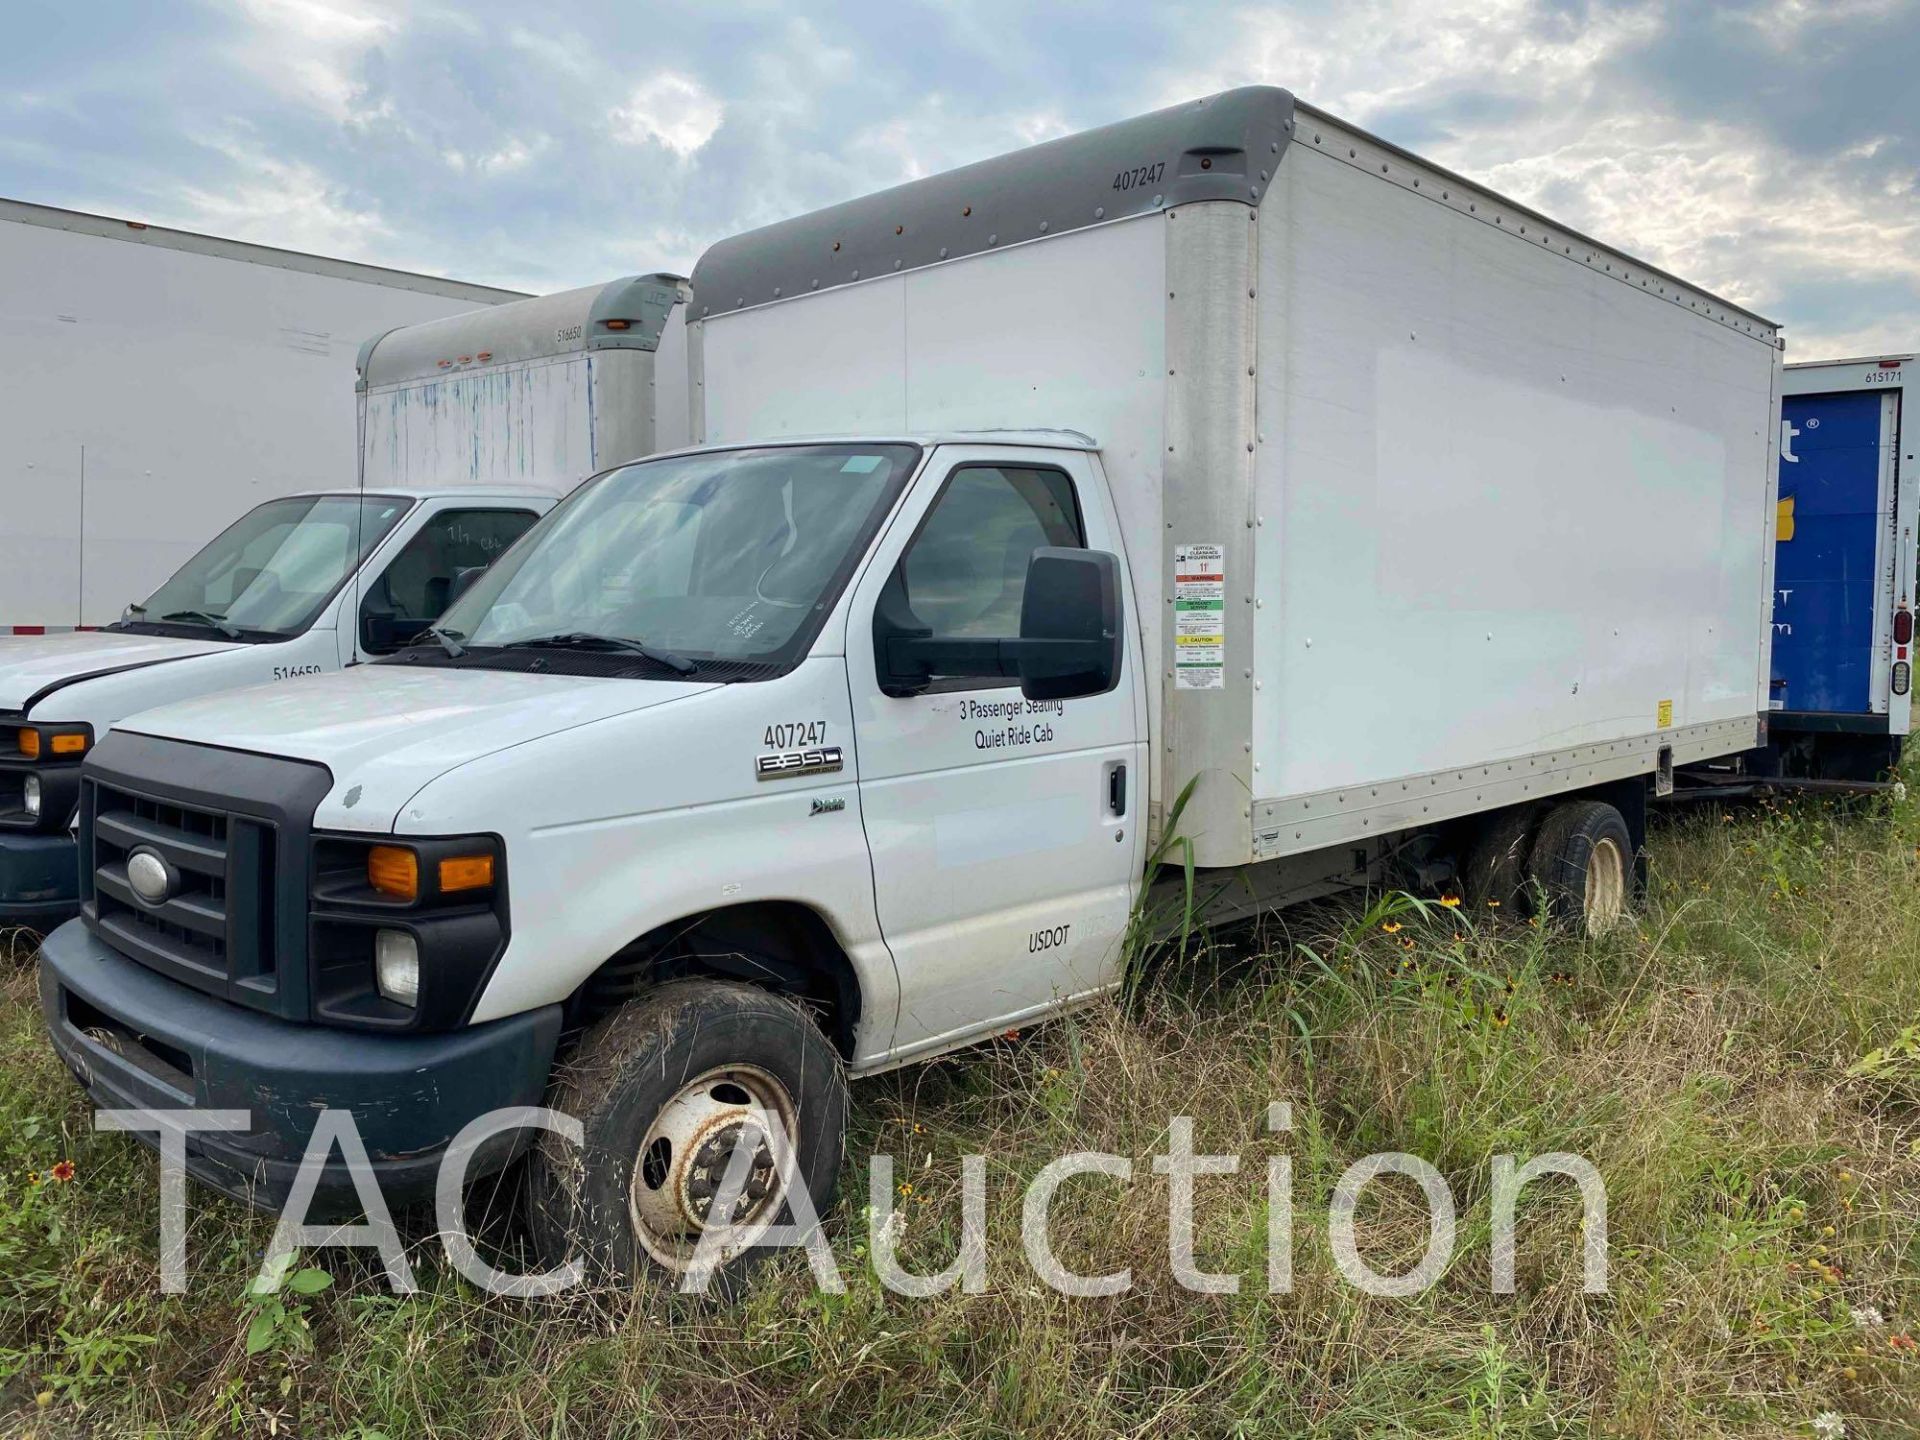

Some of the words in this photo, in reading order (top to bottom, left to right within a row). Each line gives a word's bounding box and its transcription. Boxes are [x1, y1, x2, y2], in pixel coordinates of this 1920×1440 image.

[1112, 162, 1165, 191] 407247
[557, 325, 582, 343] 516650
[1865, 371, 1901, 383] 615171
[960, 700, 967, 720] 3
[970, 699, 1023, 721] Passenger
[764, 720, 826, 749] 407247
[975, 728, 1006, 749] Quiet
[1008, 725, 1031, 746] Ride
[1033, 722, 1053, 743] Cab
[1029, 924, 1070, 953] USDOT
